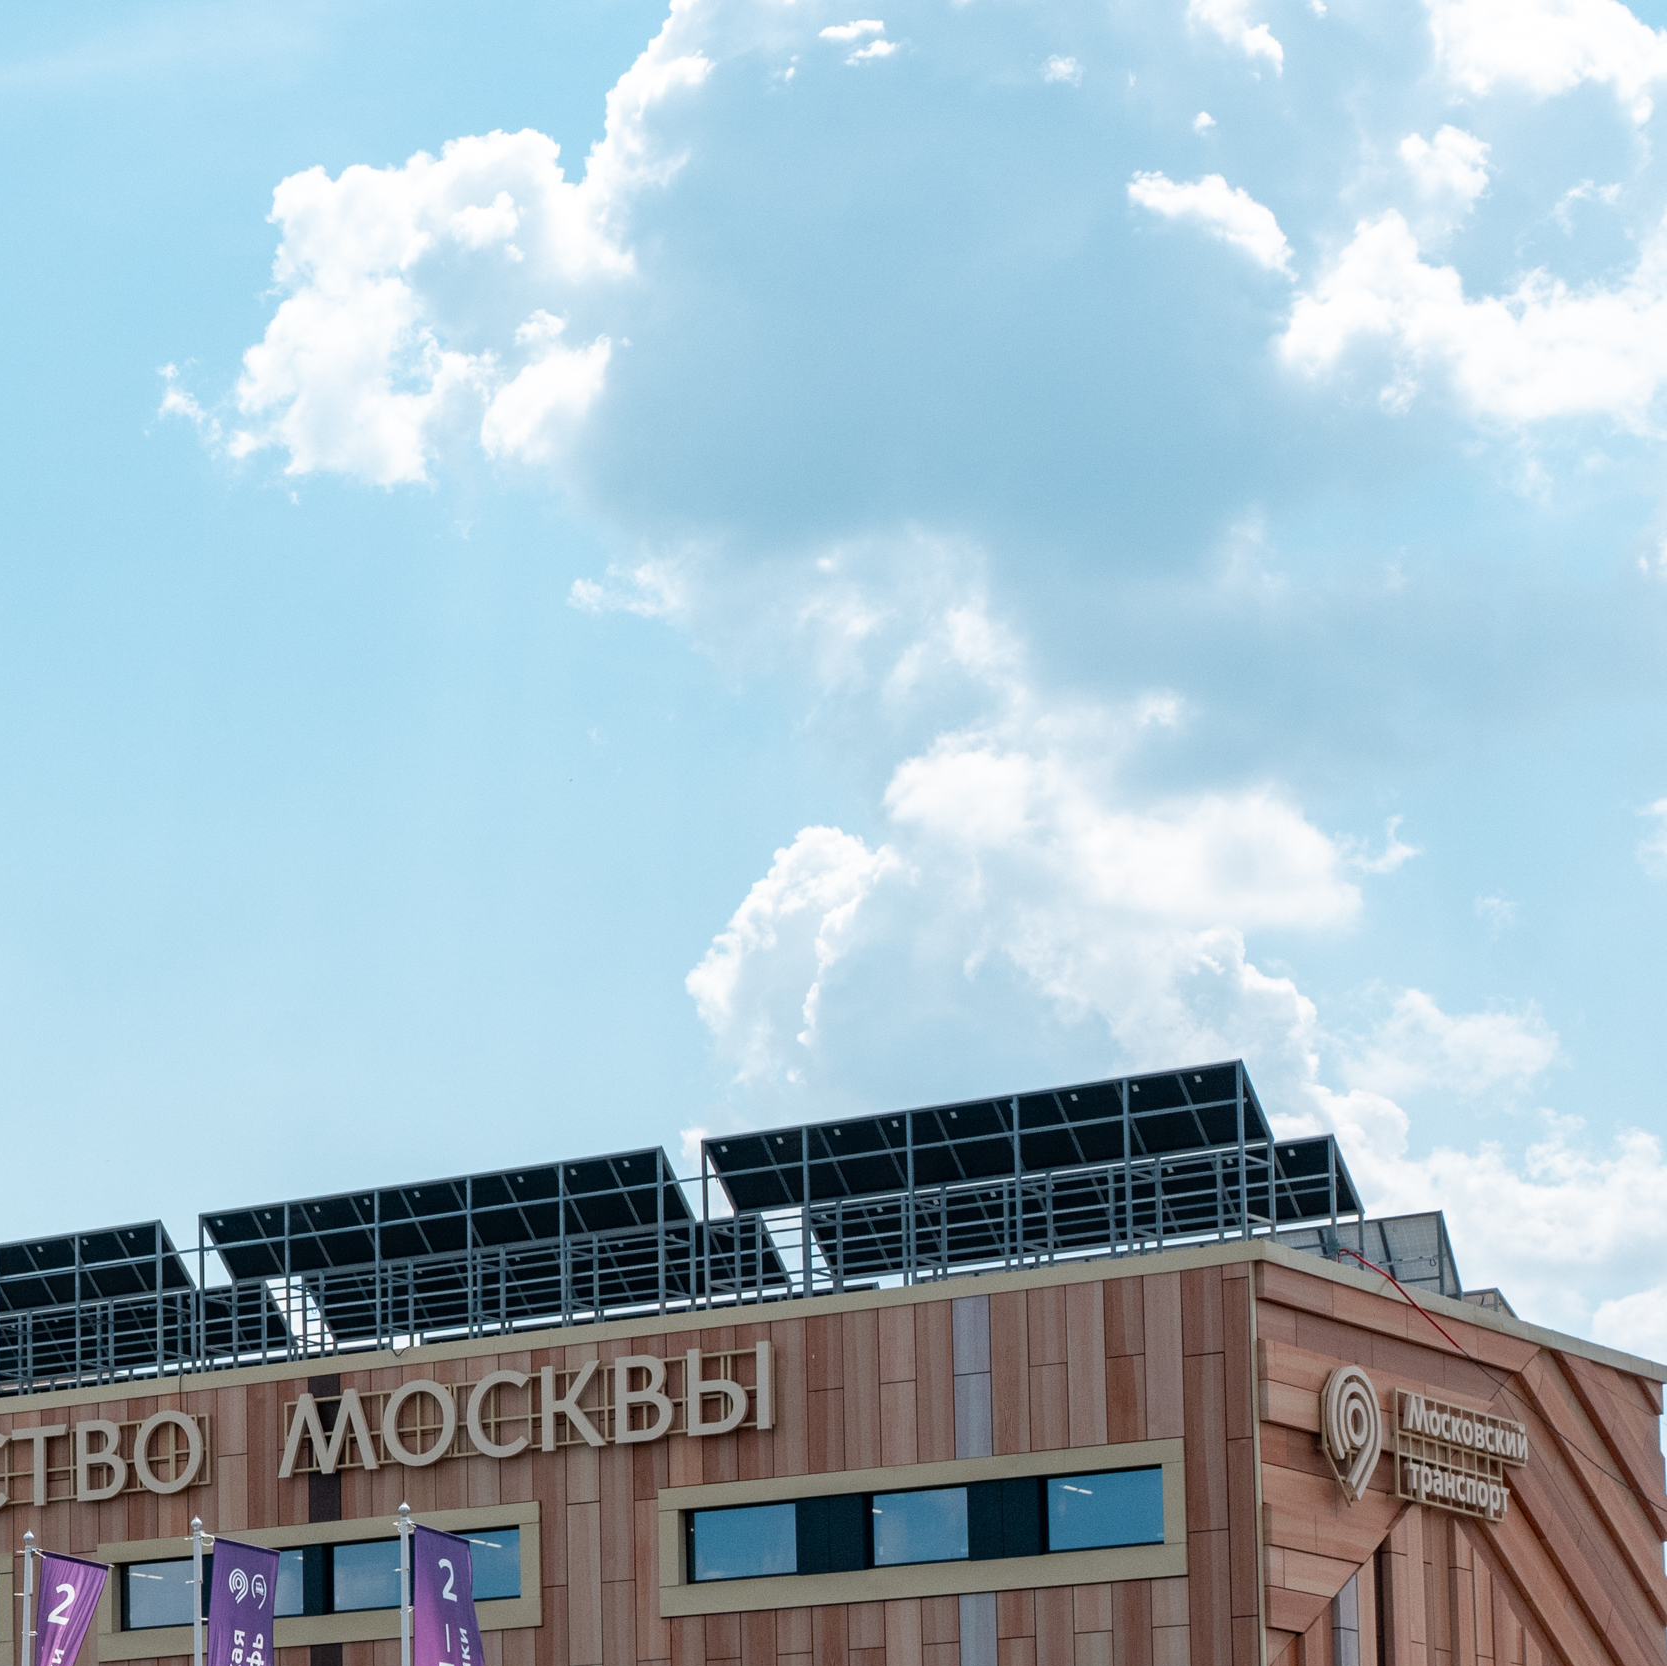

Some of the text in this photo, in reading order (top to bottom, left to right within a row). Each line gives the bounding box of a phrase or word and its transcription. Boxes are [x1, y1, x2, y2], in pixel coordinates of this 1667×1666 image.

[278, 1341, 775, 1479] МОСКВЫ
[1404, 1394, 1528, 1461] Московский
[1406, 1461, 1510, 1518] транспорт
[47, 1583, 76, 1626] 2
[438, 1558, 458, 1602] 2
